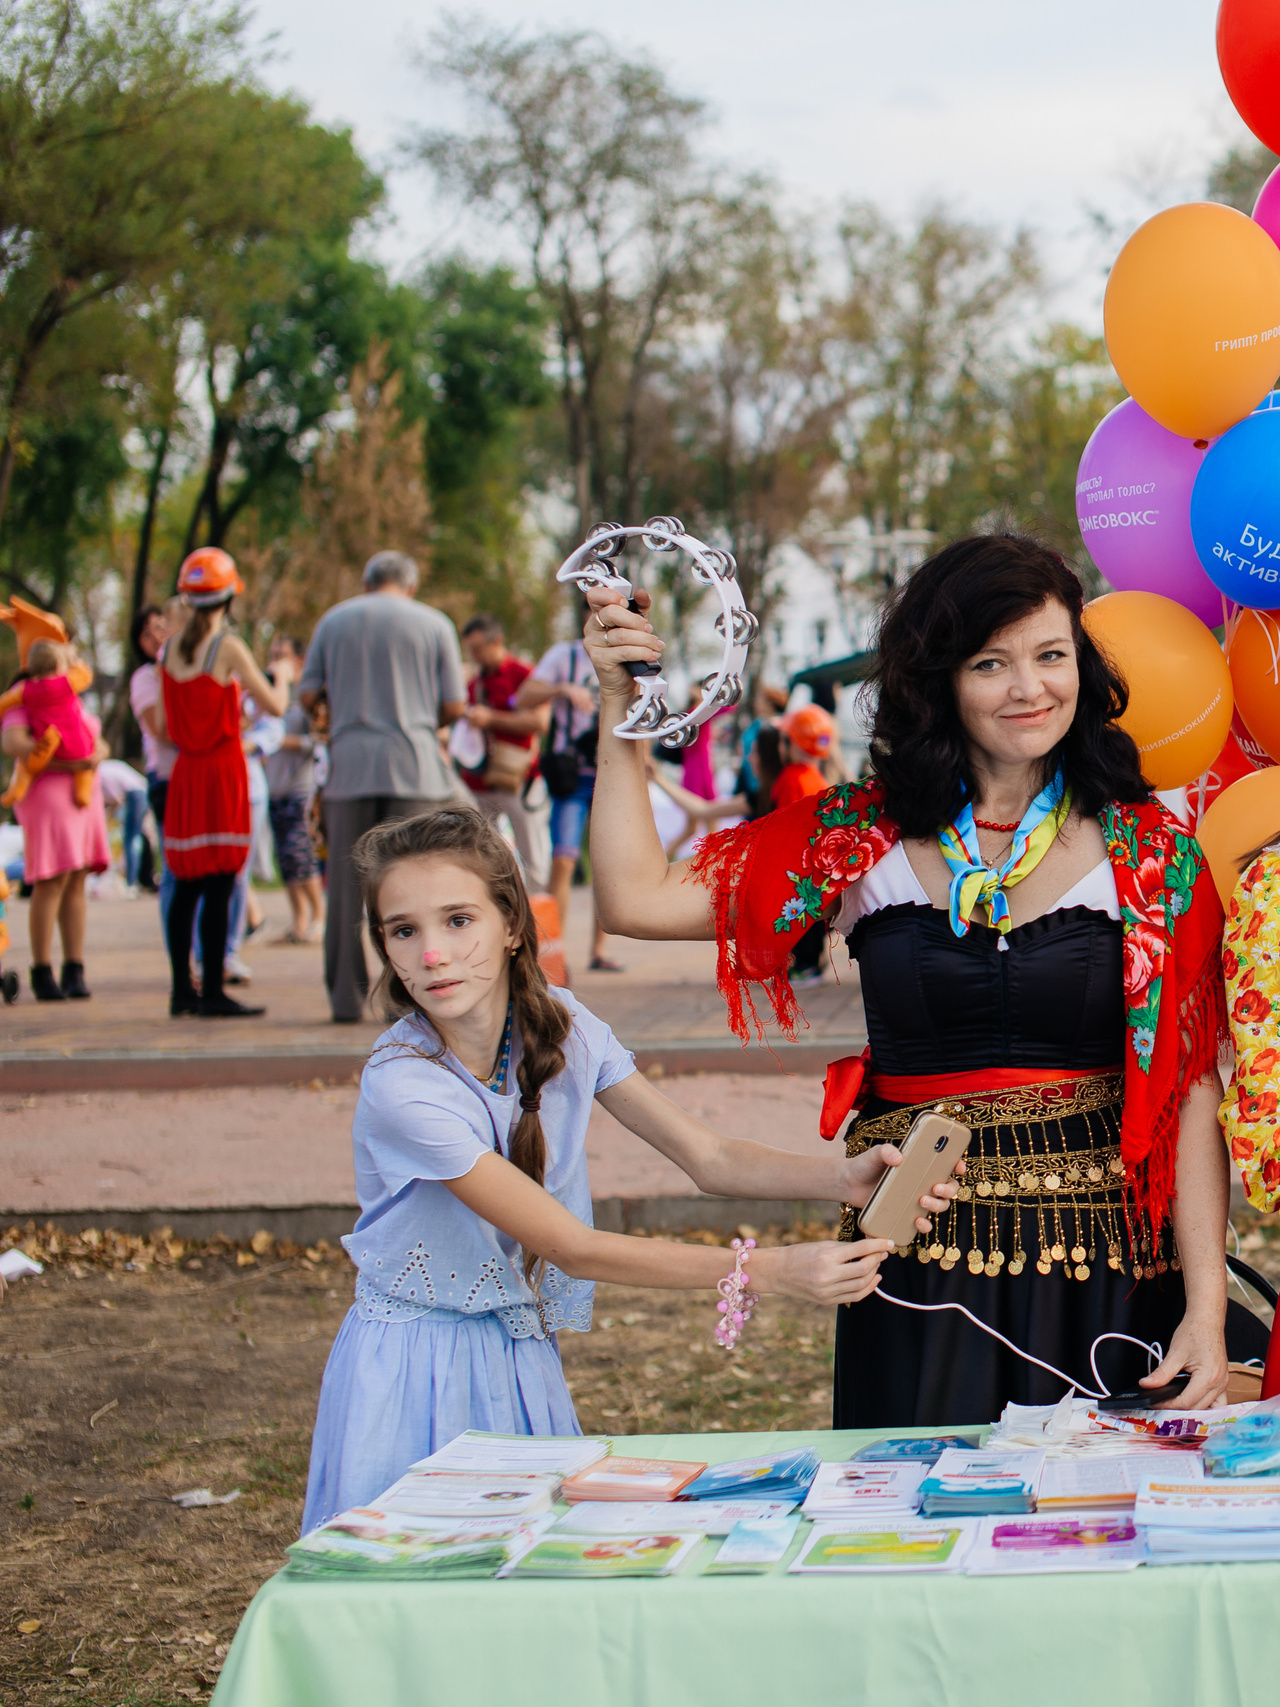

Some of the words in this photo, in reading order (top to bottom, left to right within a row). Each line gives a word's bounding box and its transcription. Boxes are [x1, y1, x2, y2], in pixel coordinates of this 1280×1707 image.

[1215, 334, 1258, 352] ГРИПП?
[1086, 489, 1114, 504] ПРОПАЛ
[1117, 482, 1156, 498] ГОЛОС?
[1079, 510, 1157, 532] ОМЕОВОКС
